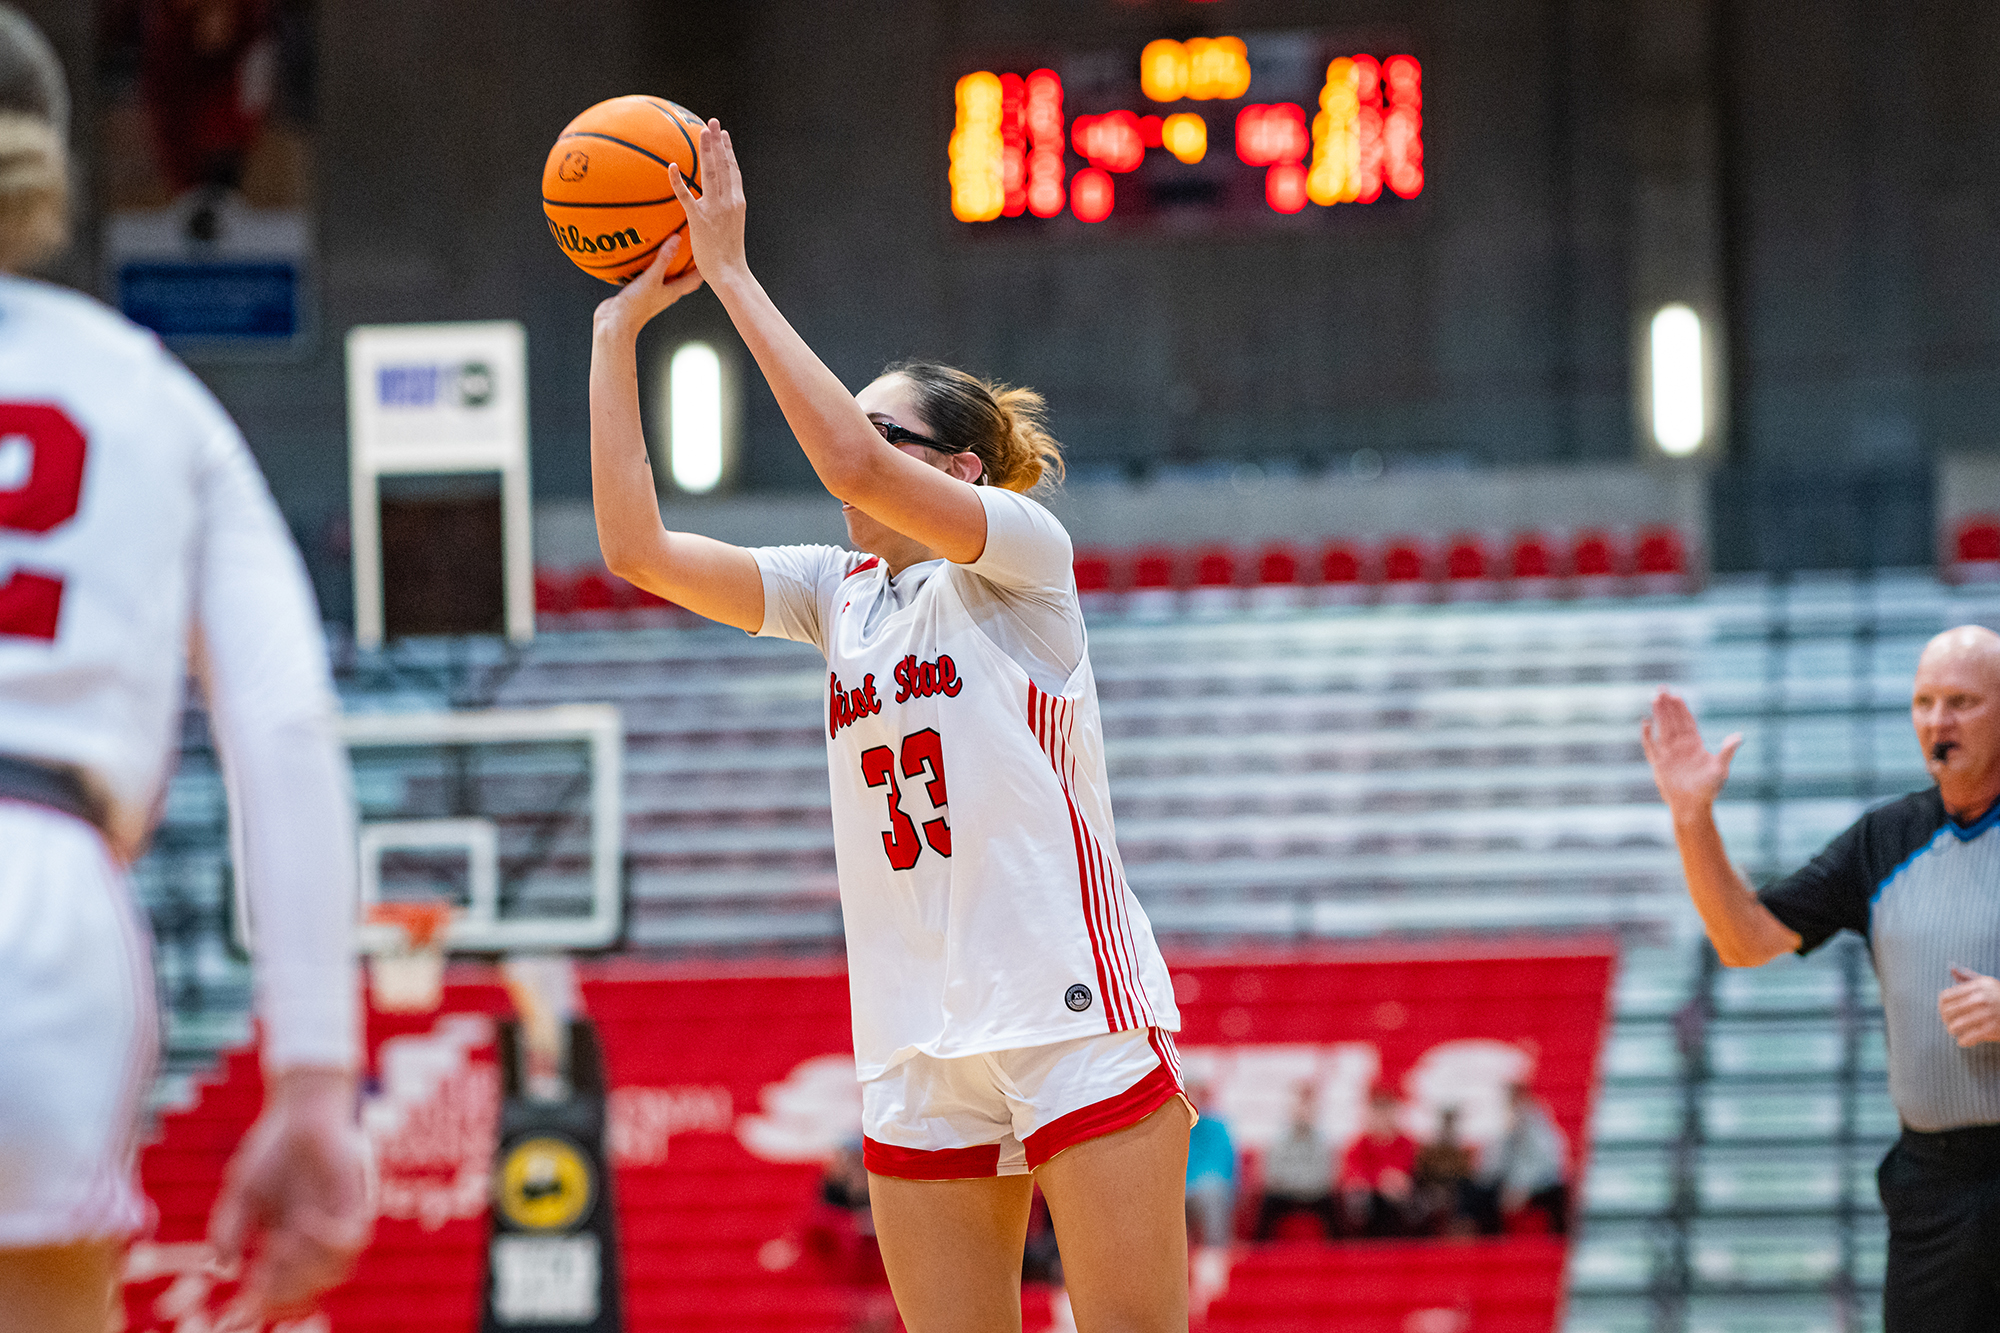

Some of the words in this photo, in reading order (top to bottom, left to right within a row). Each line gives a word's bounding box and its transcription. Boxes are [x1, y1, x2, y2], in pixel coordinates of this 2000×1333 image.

[893, 653, 963, 704] Stae
[861, 726, 952, 871] 33
[1073, 992, 1085, 1000] XL
